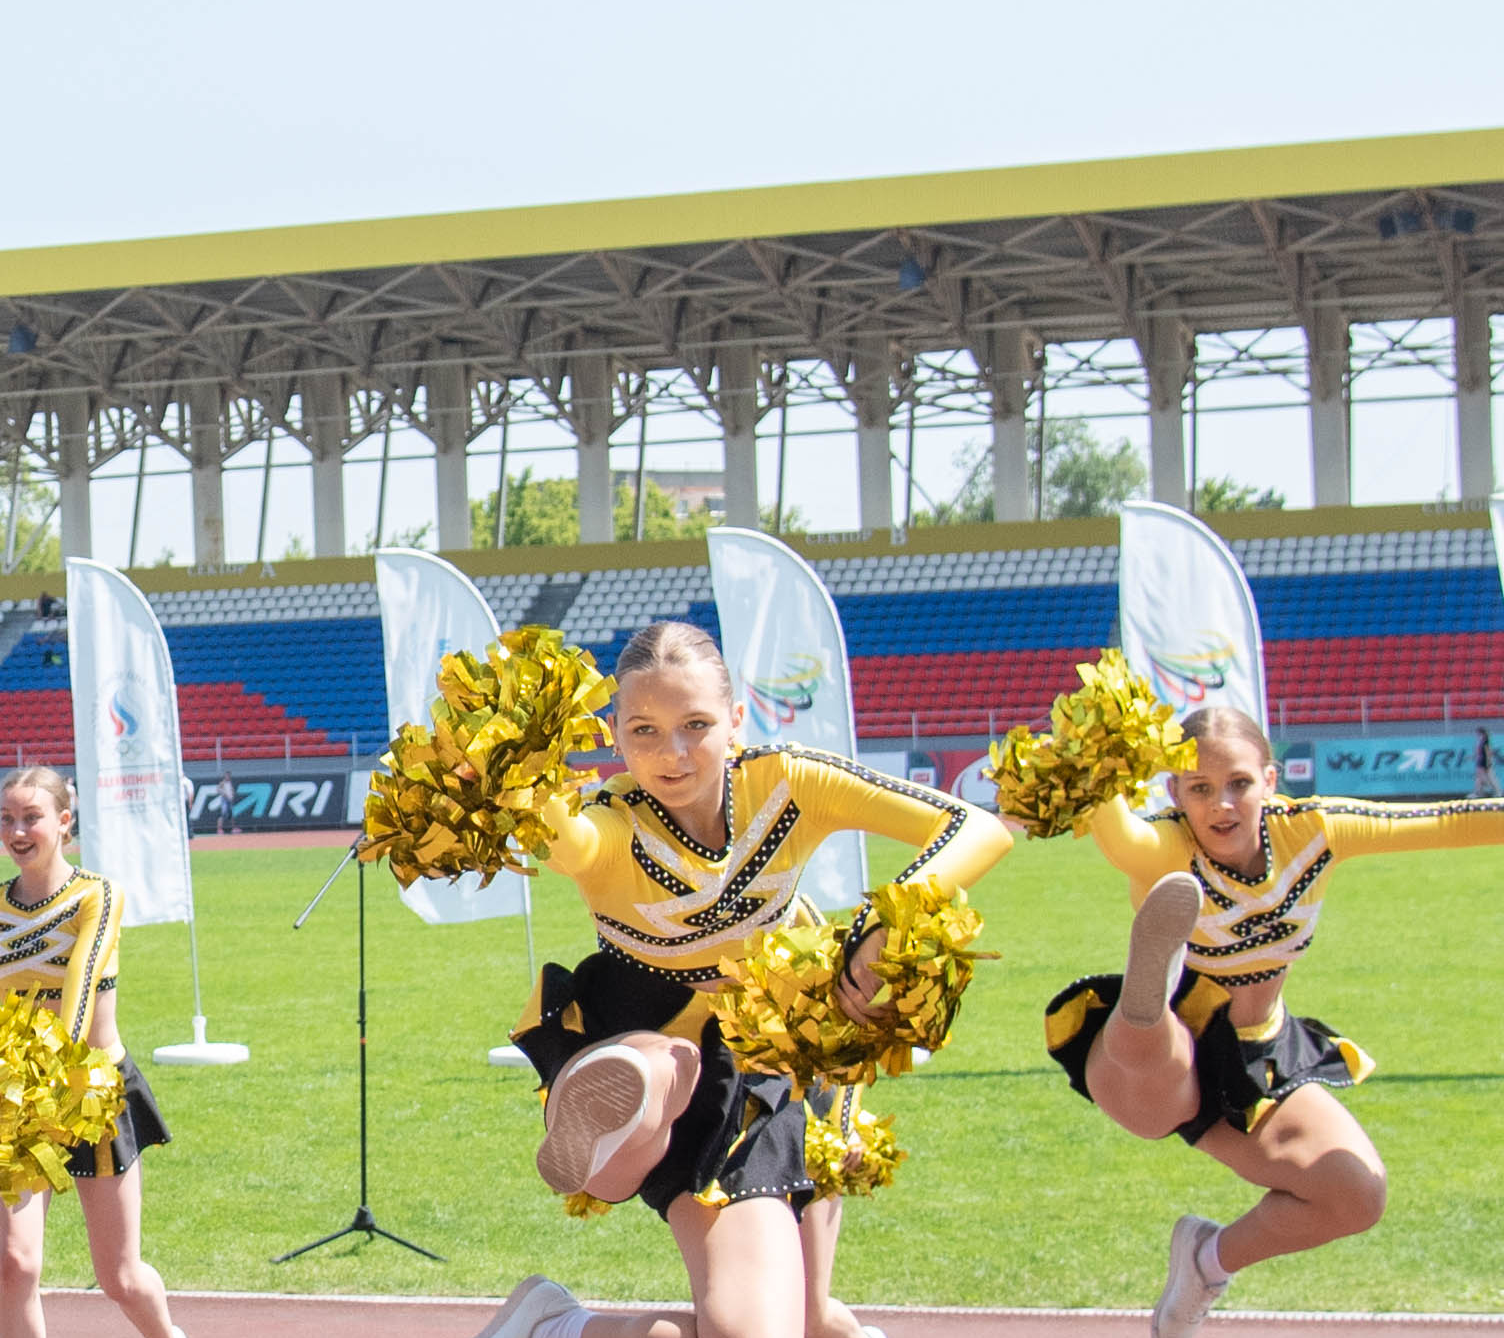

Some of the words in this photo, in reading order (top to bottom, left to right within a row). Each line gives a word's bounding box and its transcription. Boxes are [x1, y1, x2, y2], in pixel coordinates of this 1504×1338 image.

[260, 562, 278, 579] A
[1371, 748, 1467, 773] PARI
[188, 780, 334, 821] PARI
